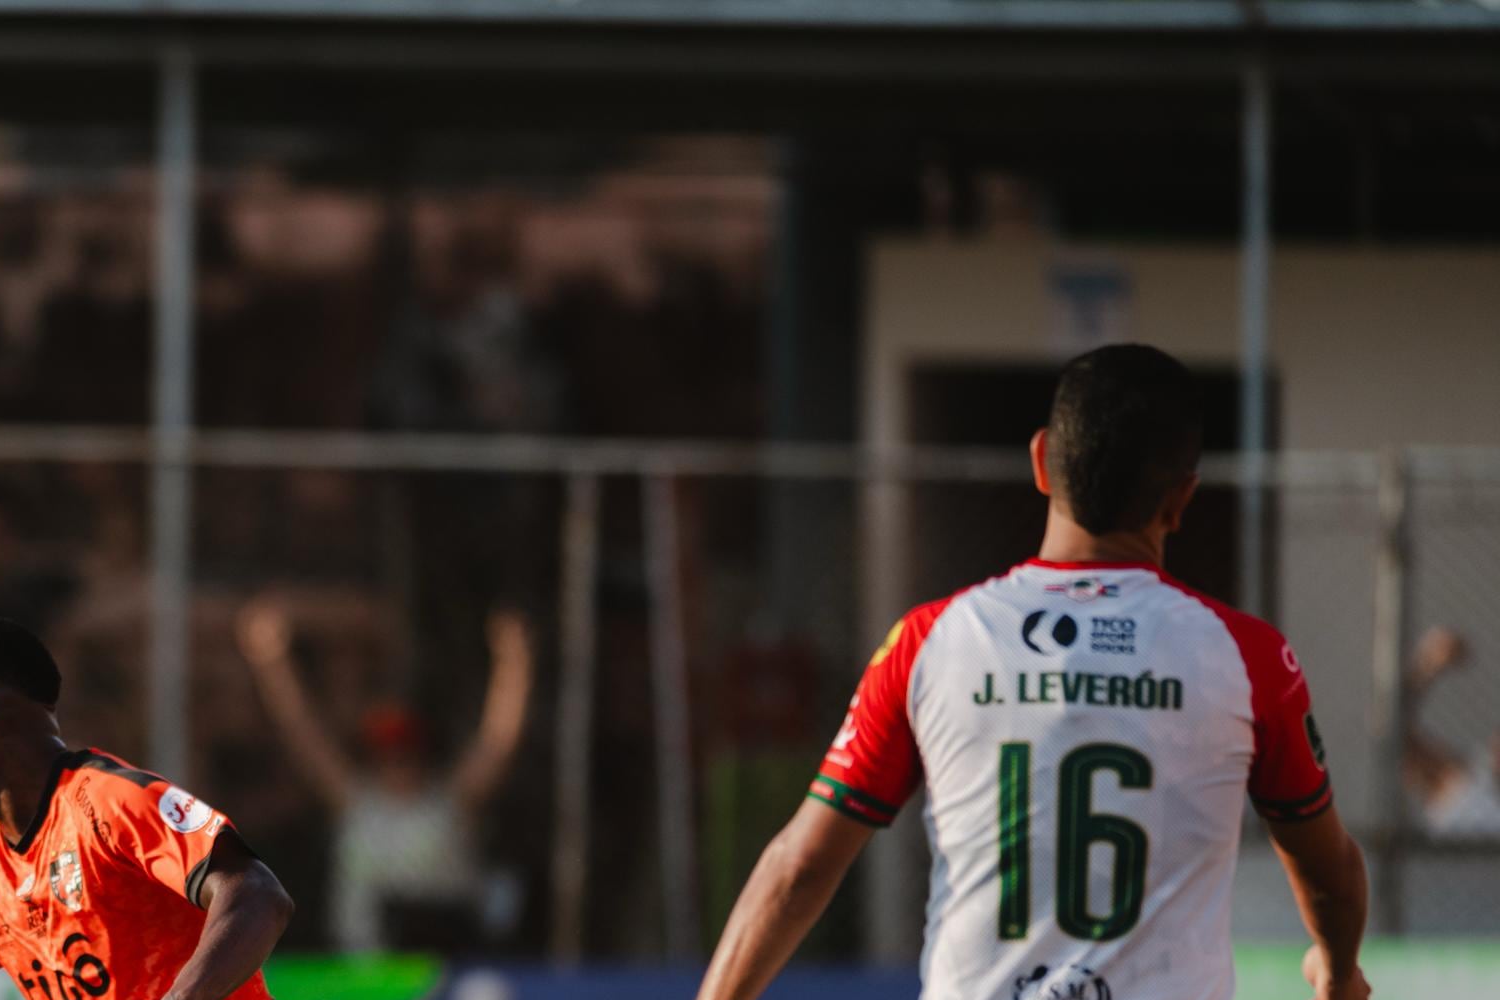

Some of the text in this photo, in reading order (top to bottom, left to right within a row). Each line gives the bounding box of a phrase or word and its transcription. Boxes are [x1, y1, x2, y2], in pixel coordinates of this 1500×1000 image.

[973, 668, 1183, 710] J. LEVERÓN
[998, 742, 1154, 943] 16
